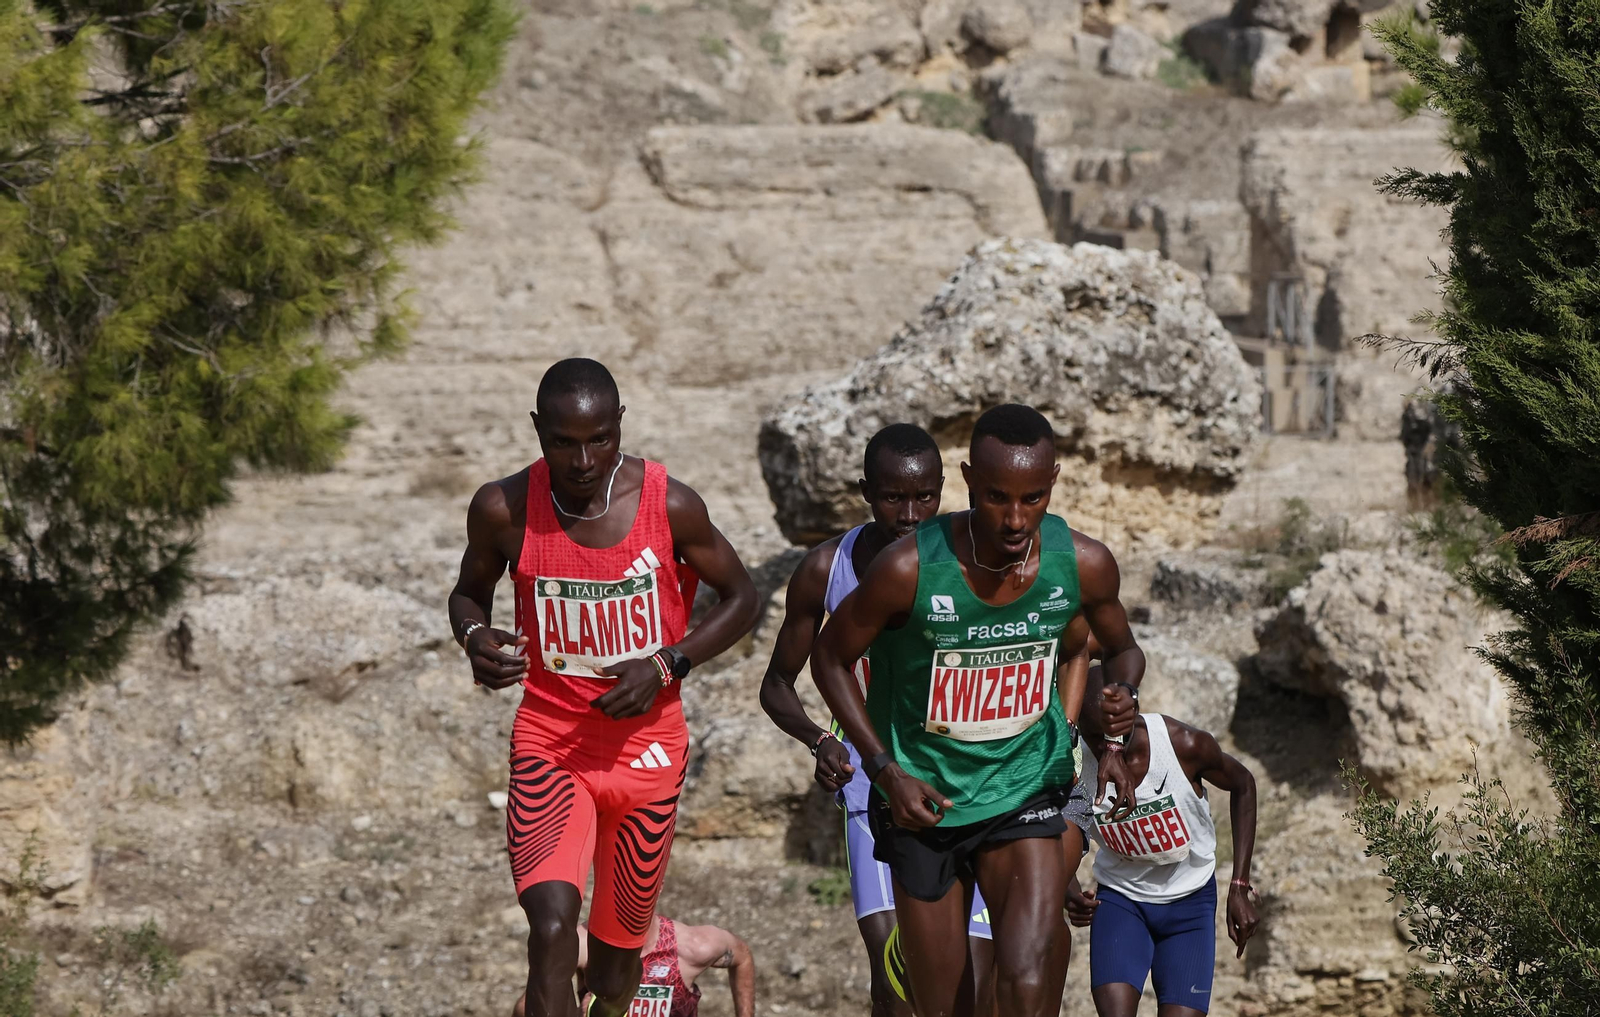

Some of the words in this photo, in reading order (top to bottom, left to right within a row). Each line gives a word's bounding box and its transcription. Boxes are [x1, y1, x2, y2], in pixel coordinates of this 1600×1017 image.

[568, 583, 624, 598] ITÁLICA
[544, 592, 657, 657] ALAMISI
[927, 613, 960, 622] rasán
[967, 621, 1029, 641] Facsa
[969, 650, 1024, 665] ITÁLICA
[930, 660, 1044, 722] KWIZERA
[1099, 807, 1190, 857] MAYEBEI
[628, 999, 667, 1017] ERAS
